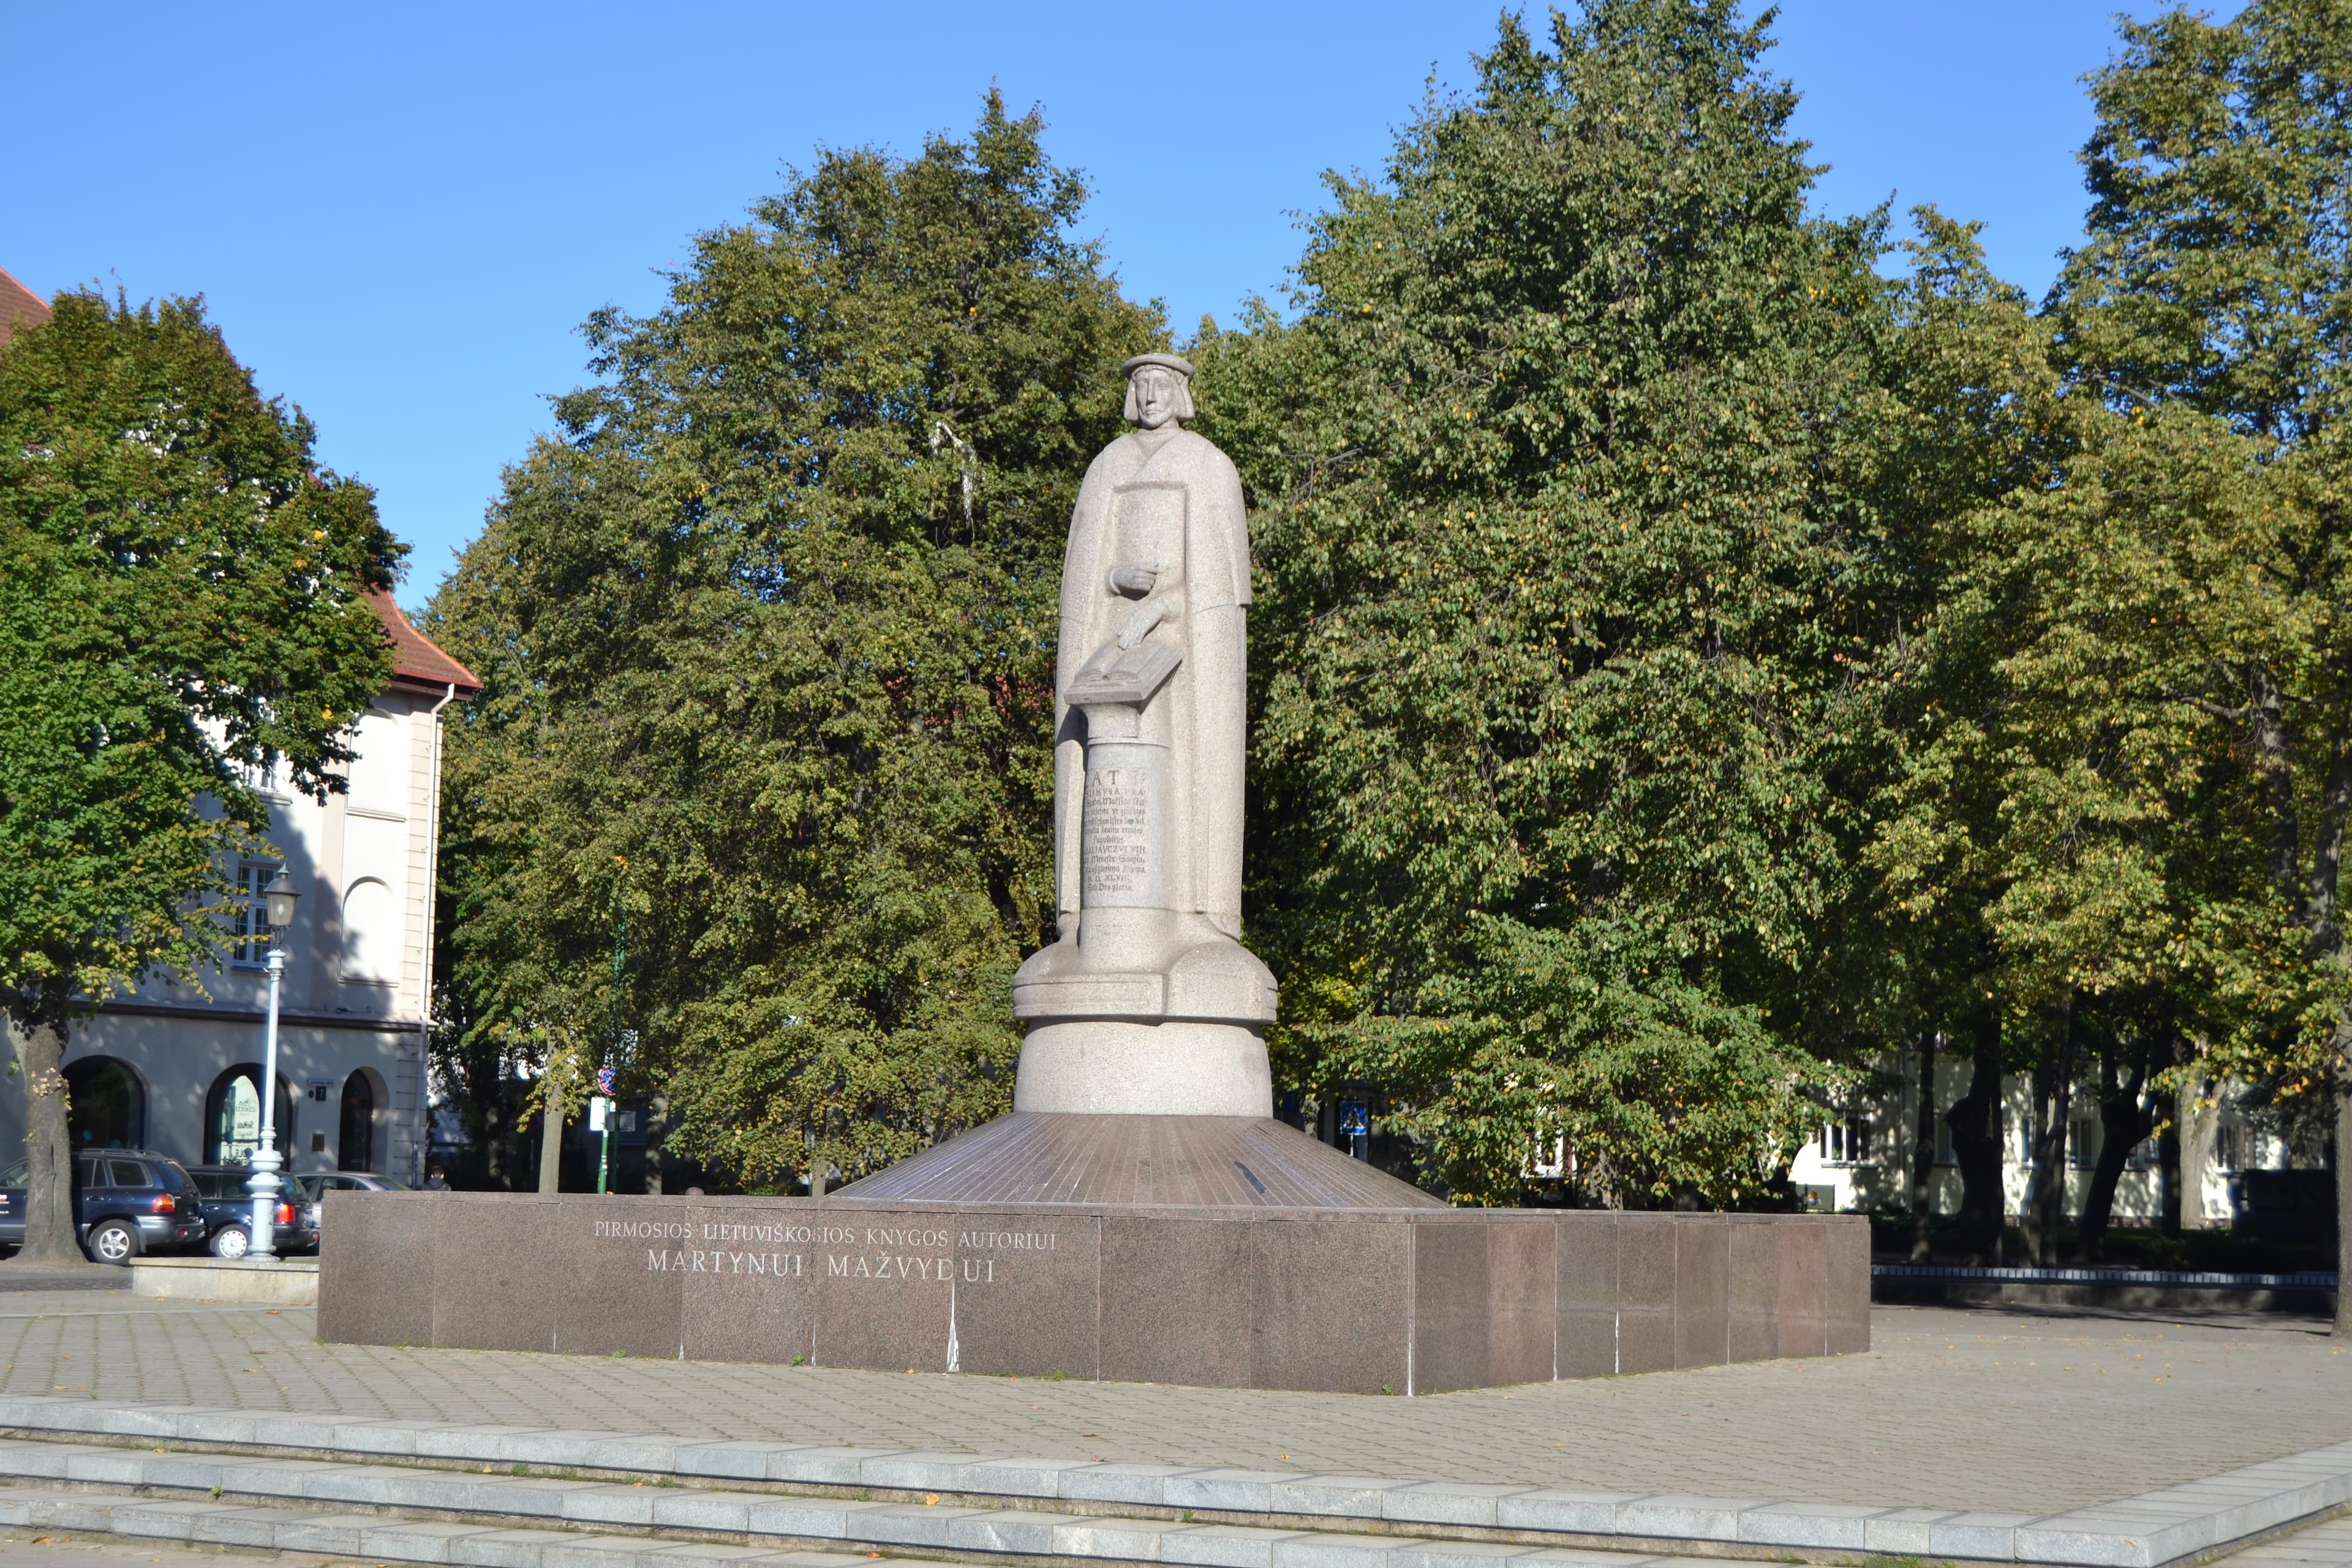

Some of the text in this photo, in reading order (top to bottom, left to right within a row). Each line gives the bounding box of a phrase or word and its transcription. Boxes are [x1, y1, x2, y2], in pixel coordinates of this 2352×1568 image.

[594, 1221, 1058, 1250] PIRMOSIOS LIETUVIŠKOSIOS KNYGOS AUTORIUI
[647, 1249, 995, 1283] MARTYNUI MAŽVYDUI
